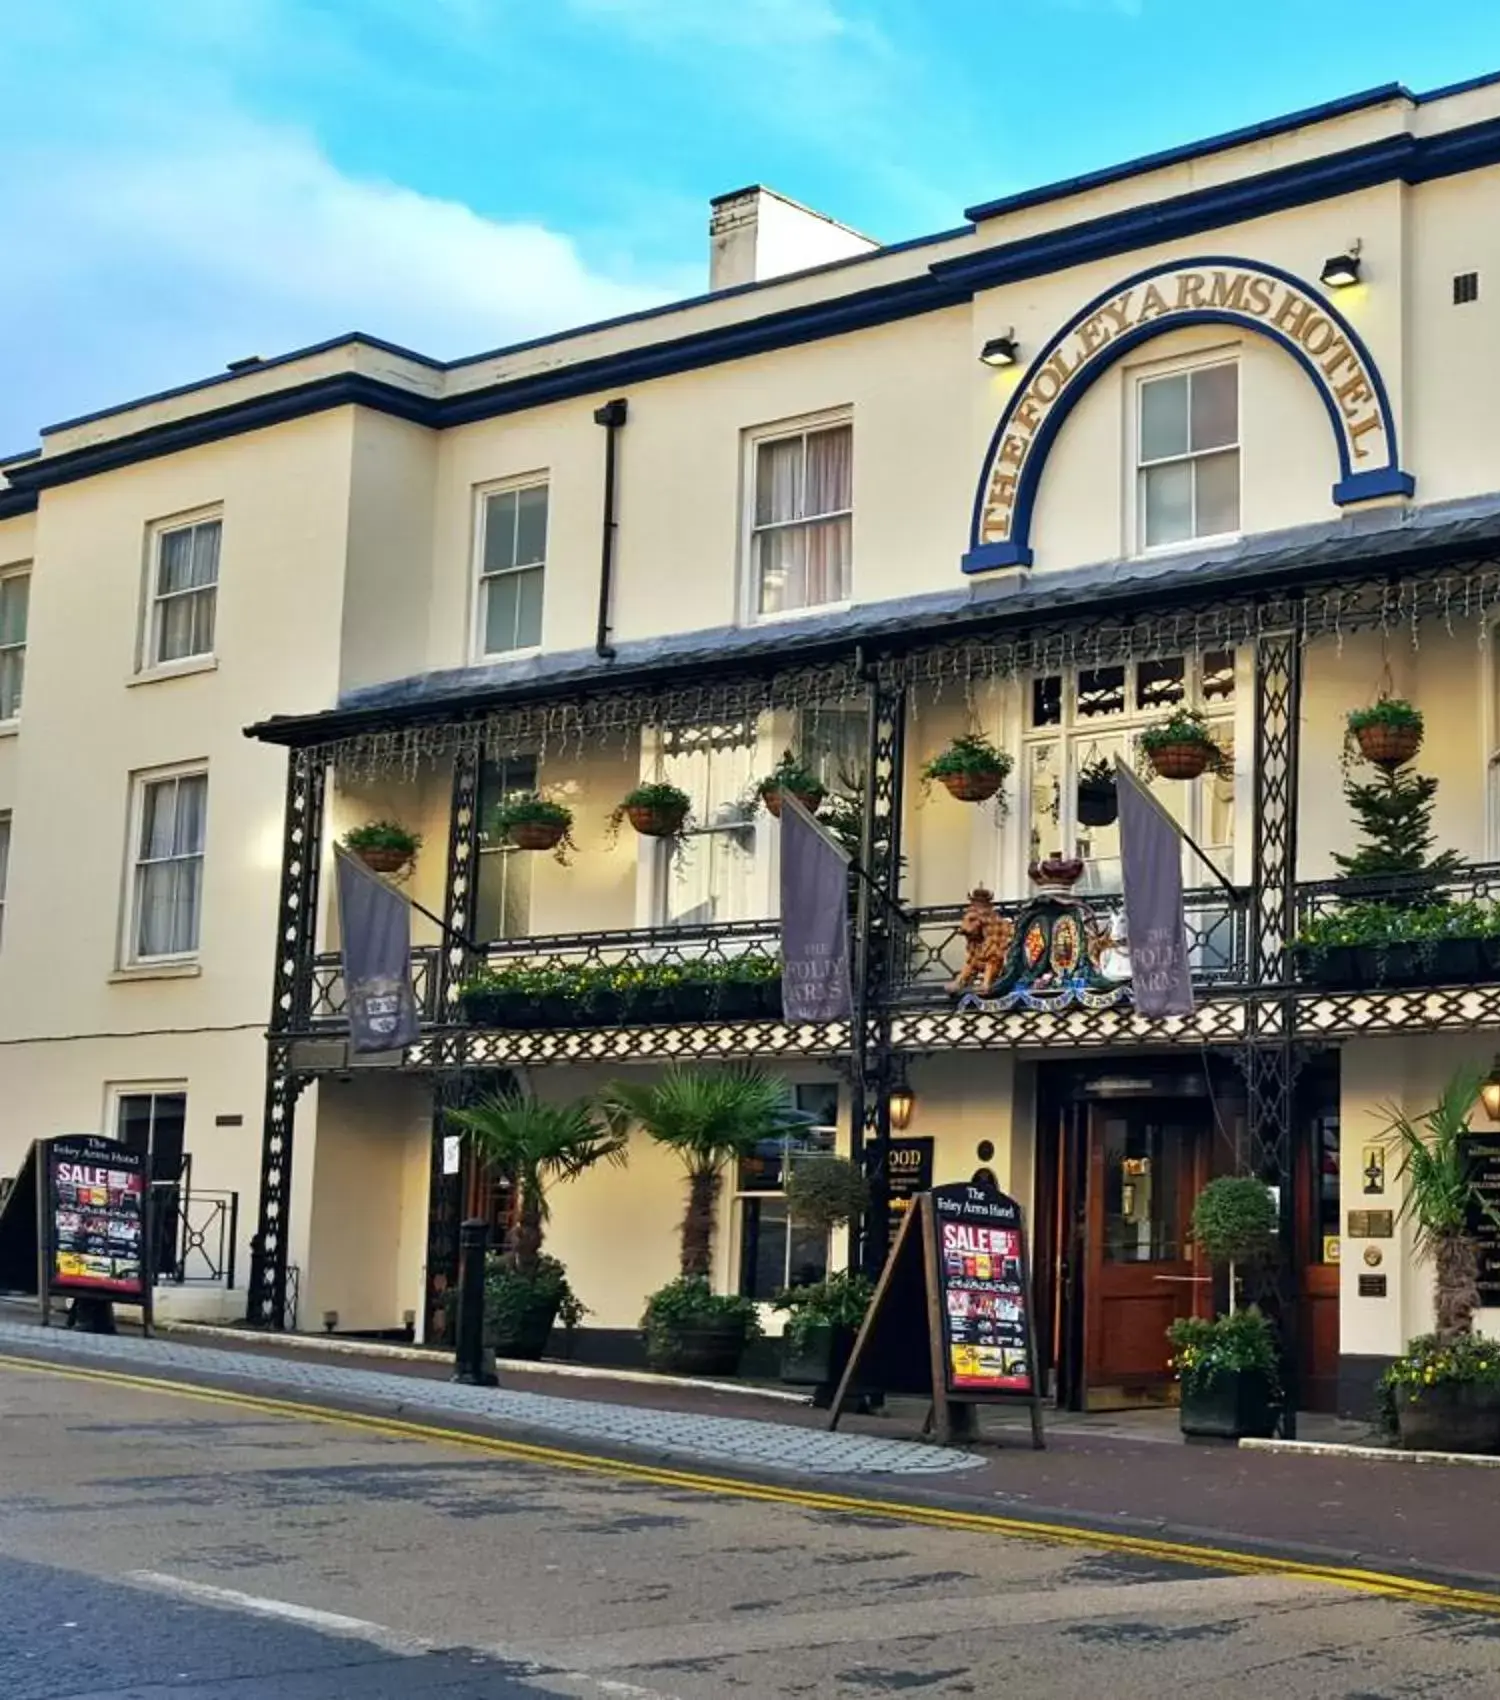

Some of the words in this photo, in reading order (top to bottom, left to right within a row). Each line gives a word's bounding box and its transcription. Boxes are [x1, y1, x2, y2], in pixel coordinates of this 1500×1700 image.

[981, 434, 1027, 543] THE
[1012, 293, 1134, 437] FOLEY
[1137, 271, 1277, 322] ARMS
[1272, 290, 1383, 459] HOTEL
[111, 1152, 140, 1165] Hotel
[889, 1149, 921, 1166] OOD
[57, 1162, 107, 1185] SALE
[966, 1187, 986, 1201] The
[936, 1197, 963, 1216] Foley
[963, 1201, 989, 1215] Arms
[989, 1204, 1015, 1219] Hotel
[944, 1223, 989, 1252] SALE
